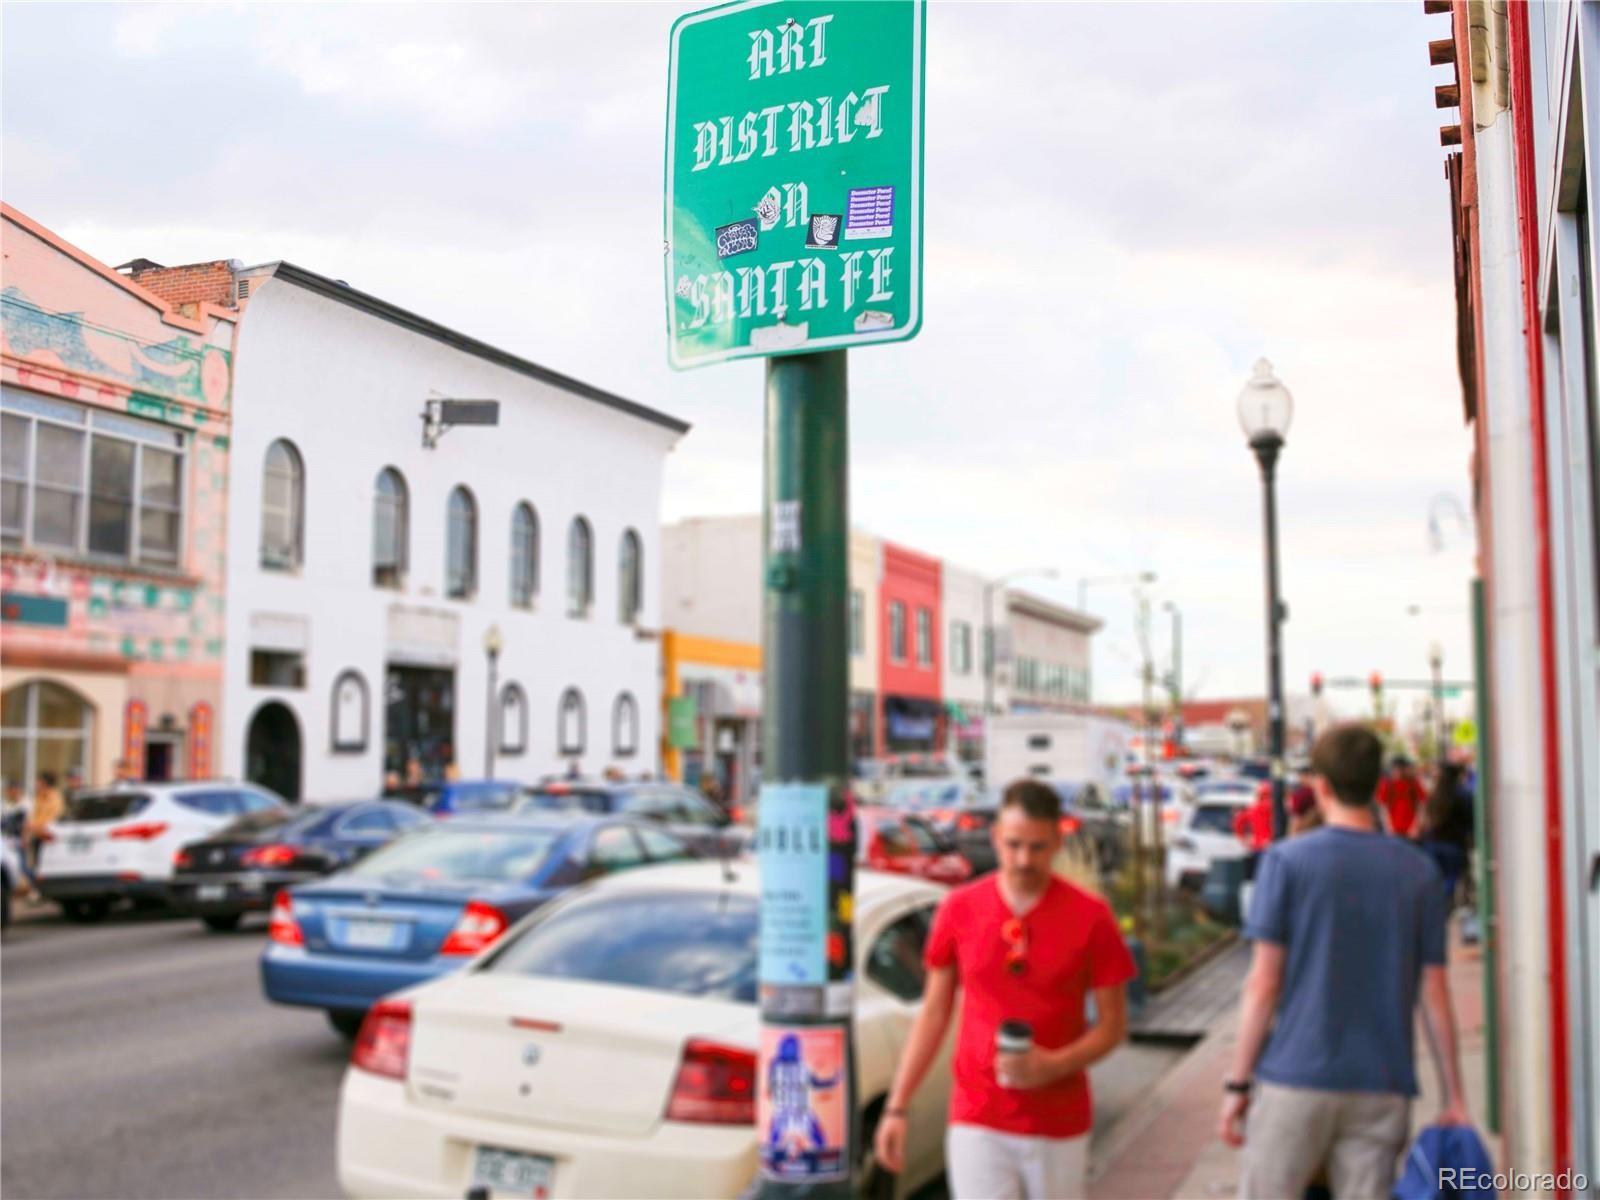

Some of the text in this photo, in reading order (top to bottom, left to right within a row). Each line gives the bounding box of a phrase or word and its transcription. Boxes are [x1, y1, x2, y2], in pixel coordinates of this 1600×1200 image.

[746, 14, 834, 80] ART
[691, 85, 890, 172] DISTRICT
[758, 181, 811, 232] ON
[689, 247, 895, 328] SANTA FE
